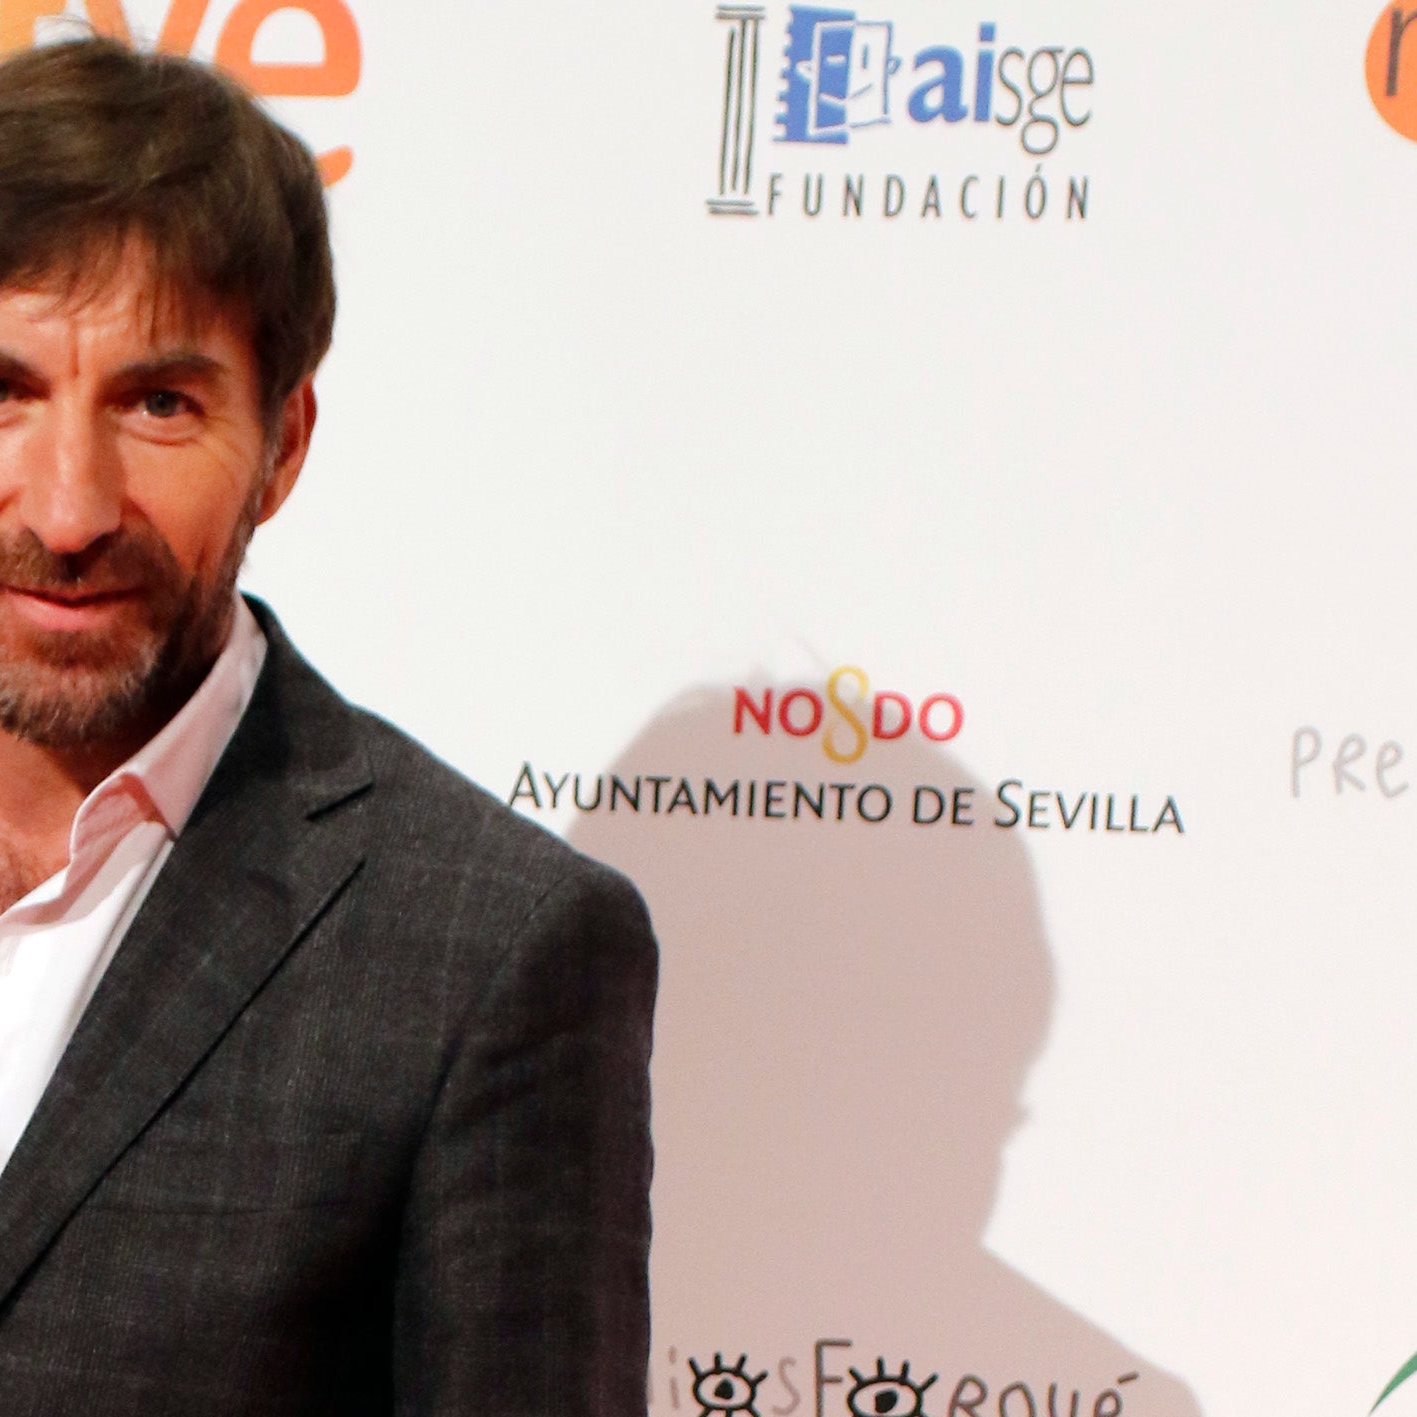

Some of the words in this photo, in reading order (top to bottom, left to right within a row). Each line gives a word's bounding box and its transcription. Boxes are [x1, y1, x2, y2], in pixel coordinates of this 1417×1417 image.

[908, 22, 1096, 155] aisge
[768, 164, 1090, 220] FUNDACIÓN
[510, 762, 893, 824] AYUNTAMIENTO
[912, 784, 975, 826] DE
[993, 779, 1186, 834] SEVILLA
